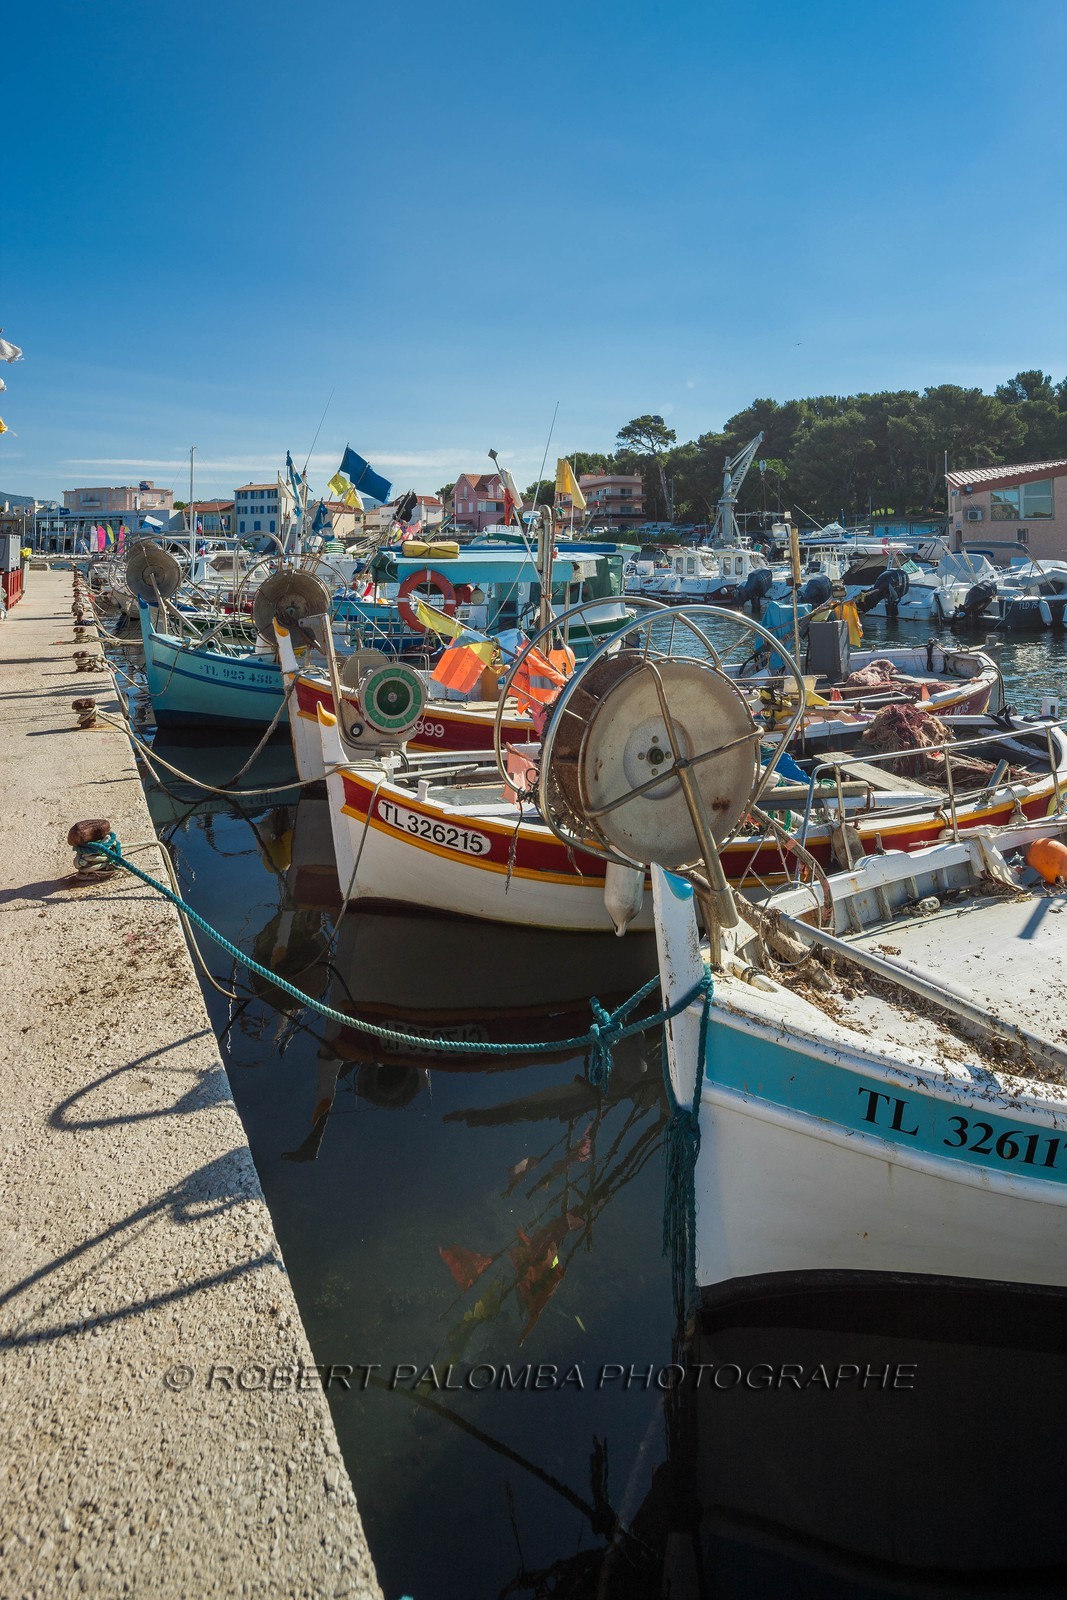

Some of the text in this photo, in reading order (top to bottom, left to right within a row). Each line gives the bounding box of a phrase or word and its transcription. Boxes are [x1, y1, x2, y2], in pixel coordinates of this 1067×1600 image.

[203, 664, 219, 677] TL
[858, 1087, 1067, 1173] TL 32611
